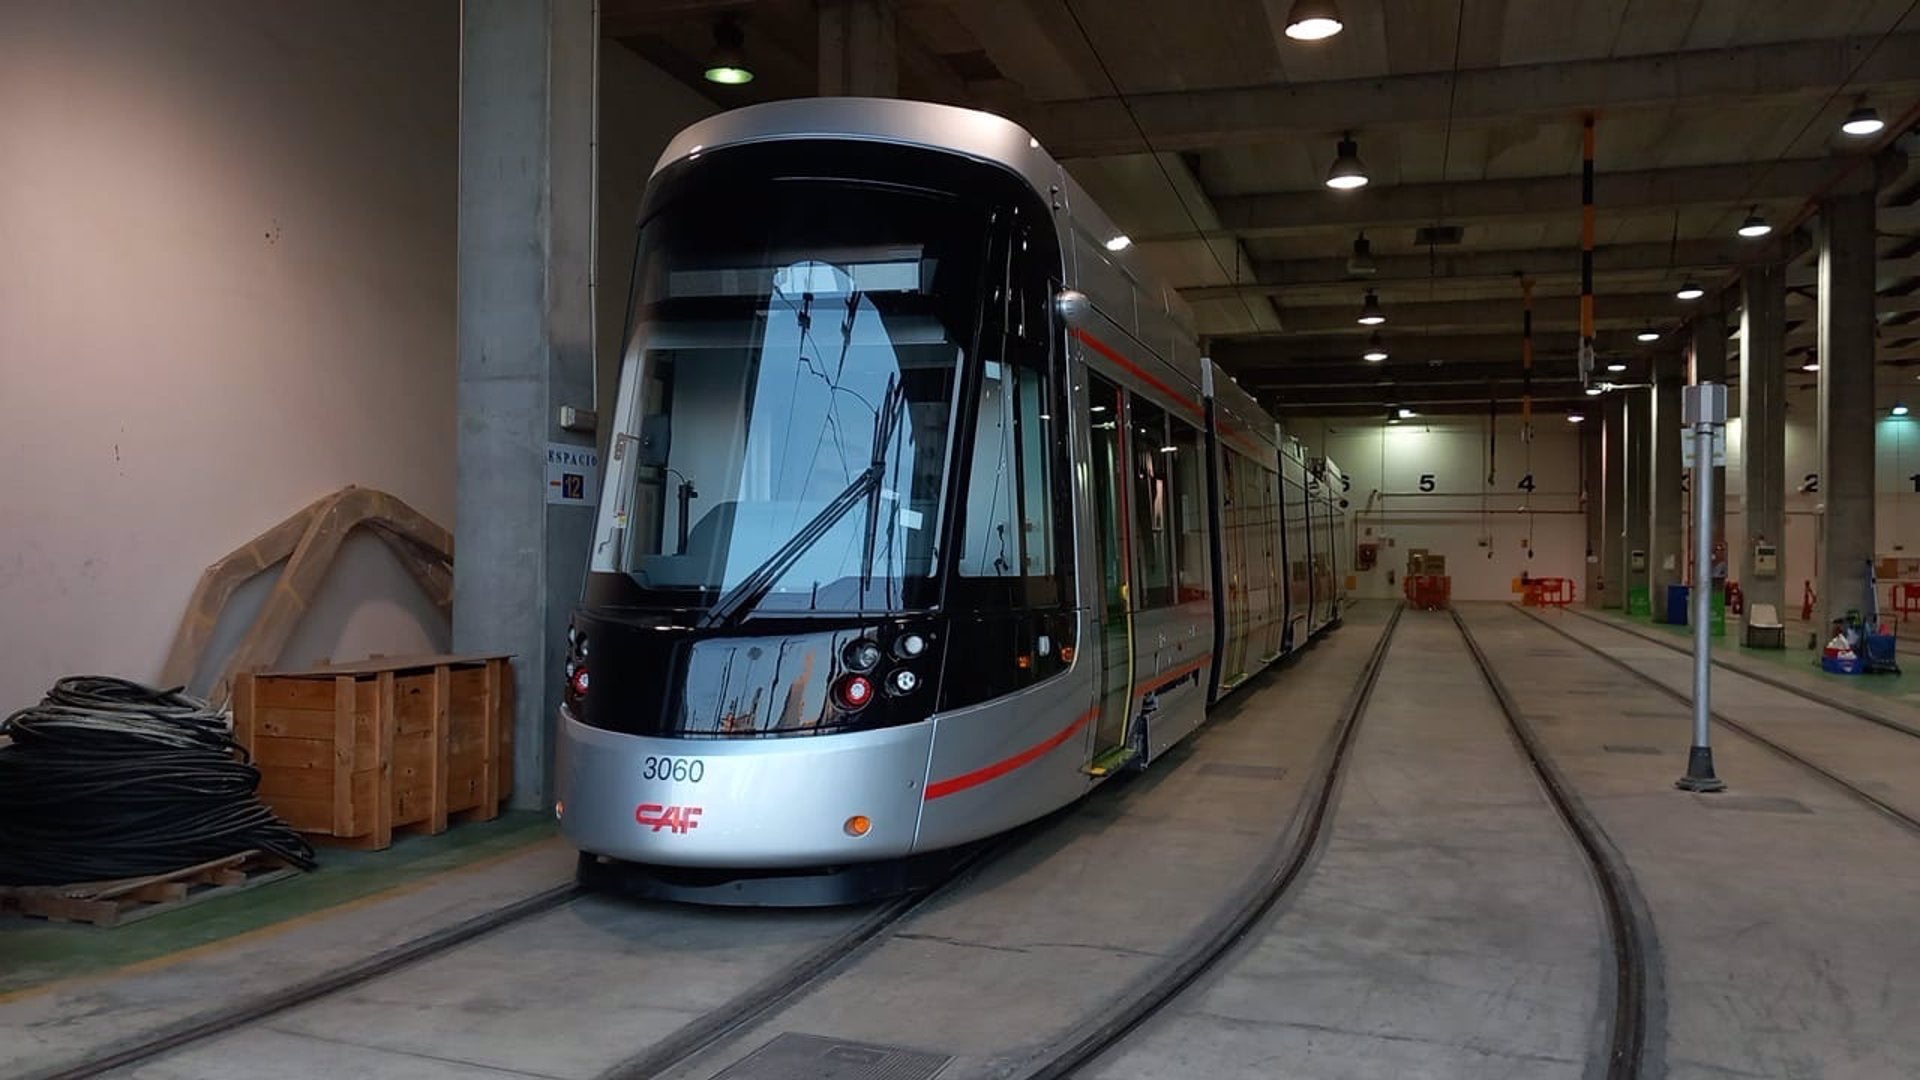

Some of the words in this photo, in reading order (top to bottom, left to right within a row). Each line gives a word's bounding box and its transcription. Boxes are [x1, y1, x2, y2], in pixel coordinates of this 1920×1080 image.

[548, 449, 598, 466] ESPACIO
[565, 476, 581, 497] 12
[1419, 474, 1435, 492] 5
[1518, 474, 1535, 492] 4
[1804, 474, 1818, 492] 2
[642, 756, 704, 783] 3060
[635, 803, 703, 834] CAF
